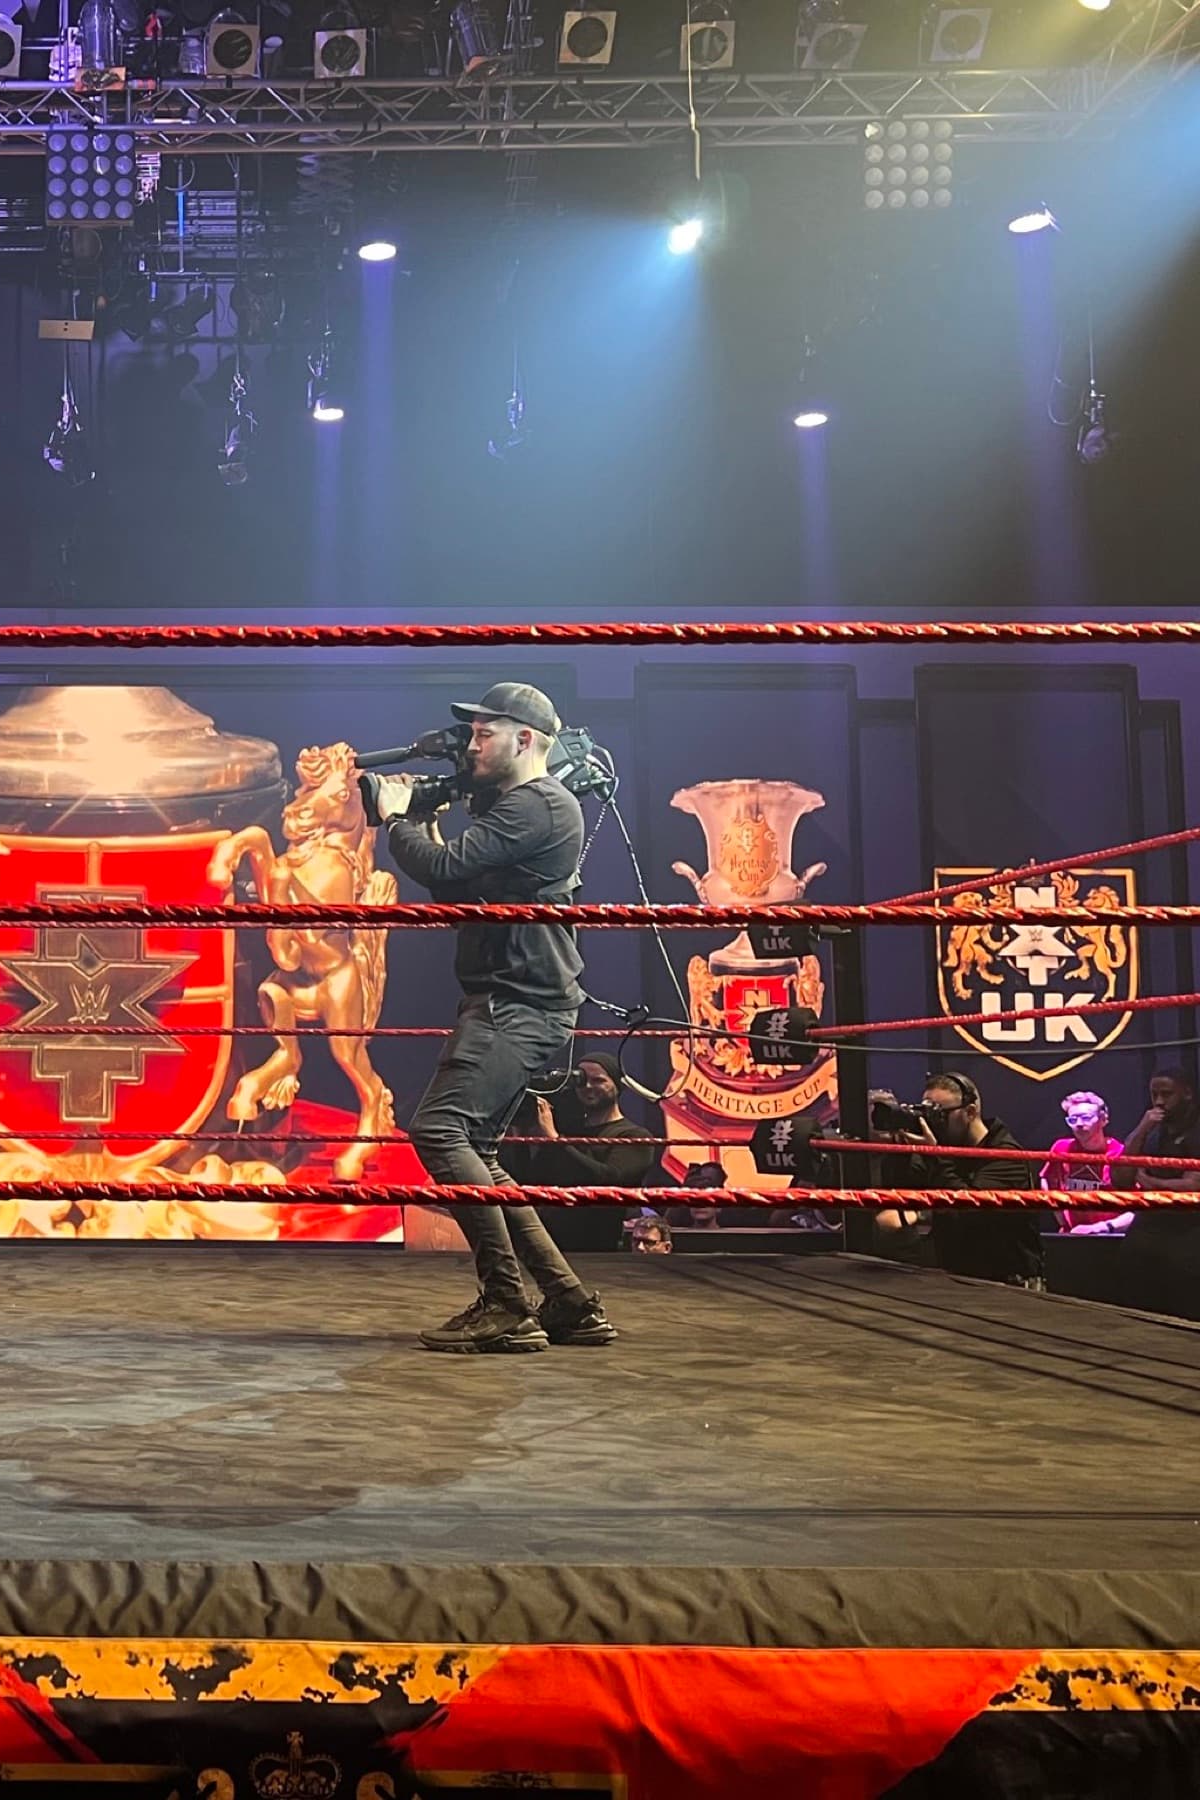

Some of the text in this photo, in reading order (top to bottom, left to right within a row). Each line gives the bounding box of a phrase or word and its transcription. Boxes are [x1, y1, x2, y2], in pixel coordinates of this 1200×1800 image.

[738, 868, 761, 885] Cup
[762, 936, 793, 950] UK
[981, 992, 1098, 1042] UK
[762, 1045, 793, 1059] UK
[693, 1077, 821, 1114] HERITAGE CUP
[765, 1153, 798, 1168] UK
